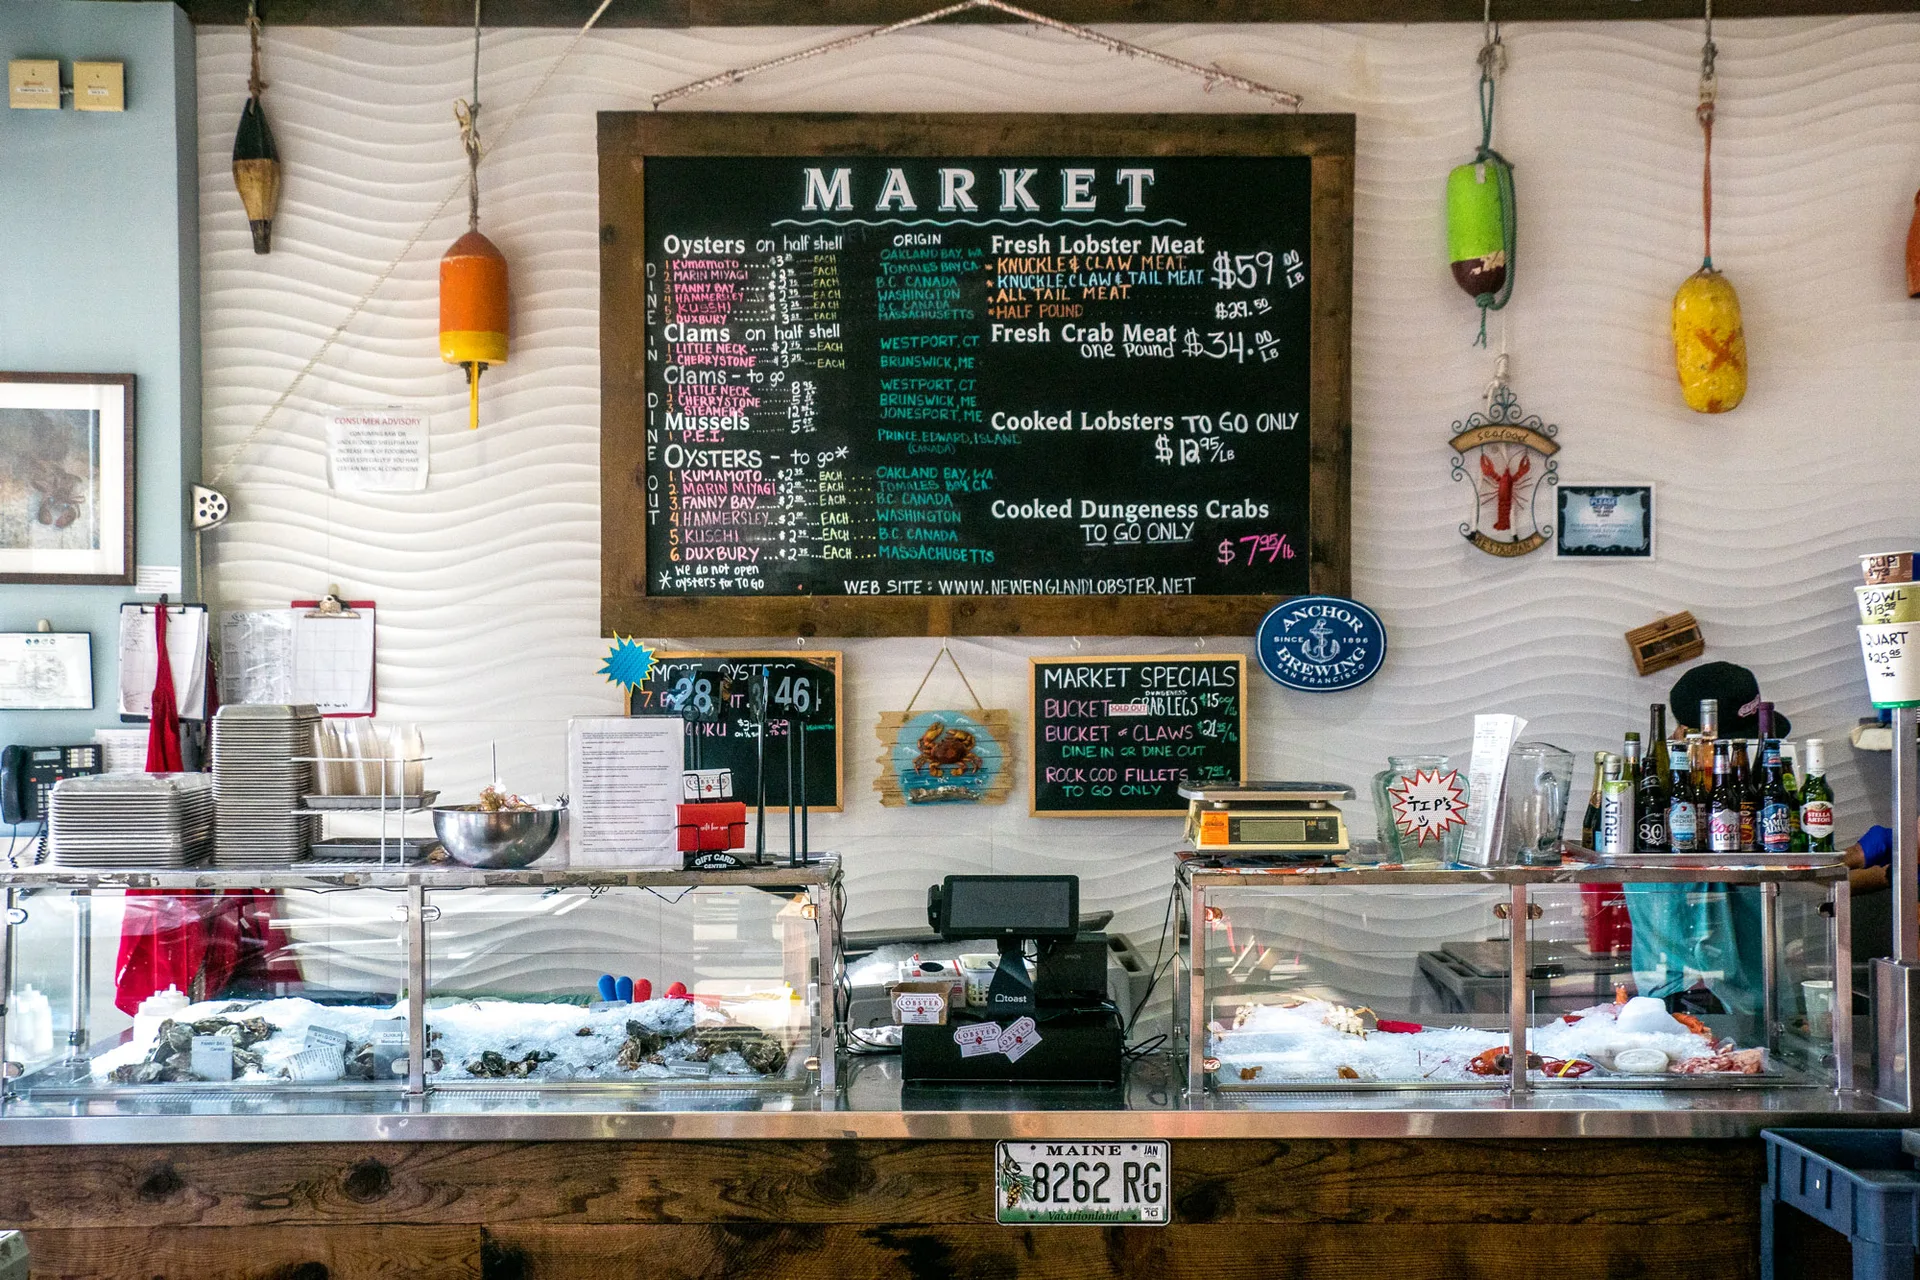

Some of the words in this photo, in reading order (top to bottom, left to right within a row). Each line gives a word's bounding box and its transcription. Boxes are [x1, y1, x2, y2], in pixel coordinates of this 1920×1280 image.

[802, 168, 1155, 211] MARKET
[663, 234, 746, 258] Oysters
[756, 239, 775, 252] on
[783, 235, 811, 251] half
[813, 235, 843, 250] shell
[893, 233, 942, 247] ORIGIN
[991, 234, 1050, 255] Fresh
[1059, 234, 1142, 255] Lobster
[1150, 235, 1205, 255] Meat
[880, 248, 939, 260] OAKLAND
[997, 256, 1067, 274] KNUCKLE
[1069, 255, 1080, 273] &
[1085, 256, 1132, 271] CLAW
[1211, 250, 1274, 290] $59
[673, 270, 707, 282] MARIN
[710, 269, 749, 281] MIYAGI
[905, 276, 958, 287] CANADA
[1128, 269, 1162, 285] TAIL
[674, 283, 711, 293] FANNY
[714, 283, 735, 293] BAY
[877, 288, 960, 301] WASHINGTON
[996, 286, 1026, 303] ALL
[1034, 286, 1070, 301] TAIL
[675, 291, 744, 303] HAMMERSLEY
[677, 303, 731, 314] KUSSHI
[902, 301, 950, 310] CANADA
[996, 303, 1033, 319] HALF
[1039, 302, 1084, 318] POUND
[676, 313, 727, 325] DUXBURY
[878, 309, 974, 320] MASSACHUSETTS
[663, 322, 731, 343] Clams
[745, 328, 766, 341] on
[774, 325, 803, 341] half
[809, 323, 840, 339] shell
[991, 322, 1051, 343] Fresh
[1061, 323, 1114, 343] Crab
[1122, 324, 1177, 343] Meat
[675, 343, 711, 354] LITTLE
[716, 343, 749, 354] NECK
[677, 354, 757, 368] CHERRYSTONE
[663, 365, 727, 385] Clams
[746, 369, 764, 383] to
[770, 371, 785, 388] go
[678, 385, 717, 396] LITTLE
[720, 385, 752, 397] NECK
[678, 394, 761, 408] CHERRYSTONE
[684, 406, 745, 418] STEAMERS
[963, 410, 983, 422] ME
[334, 417, 380, 425] CONSUMER
[381, 417, 422, 425] ADVISORY
[664, 411, 750, 431] Mussels
[991, 411, 1073, 431] Cooked
[1080, 410, 1174, 431] Lobsters
[1182, 415, 1213, 434] TO
[1219, 411, 1249, 432] GO
[1256, 412, 1300, 432] ONLY
[1477, 429, 1529, 442] seafood
[664, 443, 763, 469] OYSTERS
[790, 449, 810, 465] to
[681, 469, 762, 483] KUMAMOTO
[876, 466, 938, 480] OAKLAND
[973, 468, 994, 480] WA
[682, 483, 729, 495] MARIN
[732, 482, 777, 496] MIYAGI
[878, 480, 939, 492] TOMALES
[682, 496, 727, 509] FANNY
[730, 496, 757, 509] BAY
[901, 493, 954, 507] CANADA
[876, 508, 962, 523] WASHINGTON
[991, 498, 1072, 519] Cooked
[1080, 500, 1198, 523] Dungeness
[1205, 498, 1270, 519] Crabs
[683, 511, 769, 527] HAMMERSLEY
[822, 528, 850, 542] EACH
[906, 528, 958, 542] CANADA
[1080, 524, 1108, 542] TO
[1113, 523, 1142, 542] GO
[1147, 522, 1195, 542] ONLY
[685, 547, 760, 562] DUXBURY
[823, 545, 852, 560] EACH
[878, 545, 995, 563] MASSACHUSETTS
[696, 563, 707, 575] do
[711, 564, 730, 575] not
[734, 565, 759, 580] open
[675, 577, 716, 590] oysters
[718, 578, 734, 589] for
[735, 579, 749, 589] TO
[750, 579, 765, 590] GO
[844, 580, 881, 594] WEB
[938, 577, 1196, 596] WWW.NEWENGLANDLOBSTER.NET
[1282, 605, 1364, 634] ANCHOR
[1276, 646, 1366, 677] BREWING
[1044, 667, 1132, 689] MARKET
[1140, 666, 1237, 688] SPECIALS
[1277, 663, 1298, 678] SAN
[1302, 663, 1365, 684] FRANCISCO
[674, 677, 713, 713] 28
[774, 676, 811, 713] 46
[1044, 699, 1112, 718] BUCKET
[1167, 696, 1198, 716] LEGS
[1045, 725, 1111, 742] BUCKET
[1133, 724, 1194, 742] CLAWS
[1062, 745, 1097, 758] DINE
[1100, 746, 1114, 758] IN
[1142, 745, 1174, 758] DINE
[1177, 745, 1206, 757] OUT
[1046, 767, 1087, 783] ROCK
[1089, 768, 1117, 783] COD
[1125, 767, 1189, 783] FILLETS
[1062, 785, 1084, 798] TO
[1091, 785, 1112, 797] GO
[1120, 785, 1162, 796] ONLY
[1604, 797, 1618, 846] TRULY
[1639, 823, 1664, 840] 80
[694, 854, 712, 866] GIFT
[713, 854, 736, 865] CARD
[1004, 994, 1027, 1003] toast
[957, 1028, 997, 1040] LOBSTER
[1046, 1145, 1122, 1156] MAINE
[1143, 1145, 1158, 1156] JAN
[1032, 1161, 1111, 1203] 8262
[1122, 1161, 1162, 1203] RG
[1048, 1210, 1120, 1221] Vacationland
[1144, 1209, 1158, 1218] 10
